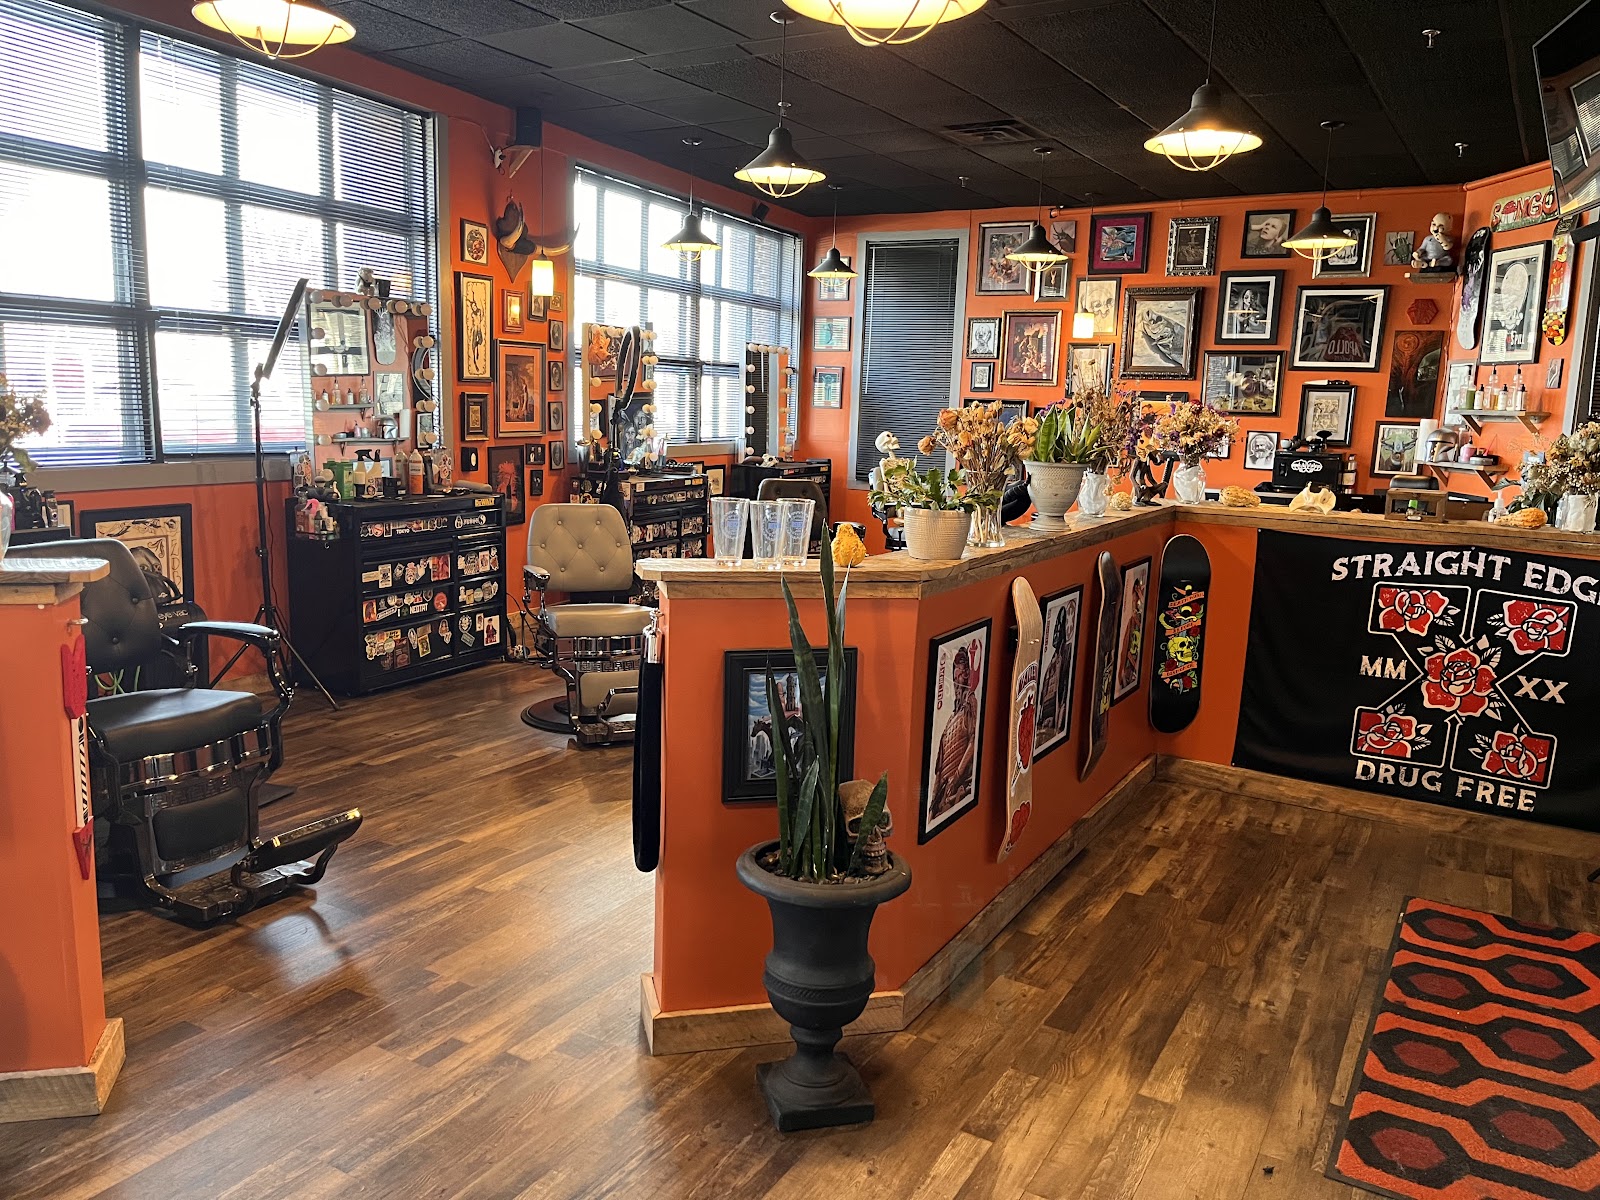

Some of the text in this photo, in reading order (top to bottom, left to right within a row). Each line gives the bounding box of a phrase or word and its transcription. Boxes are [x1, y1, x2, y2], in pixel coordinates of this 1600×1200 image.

[1332, 551, 1600, 606] STRAIGHT EDG
[1360, 655, 1407, 680] MM
[1514, 675, 1568, 704] XX
[1355, 760, 1537, 813] DRUG FREE
